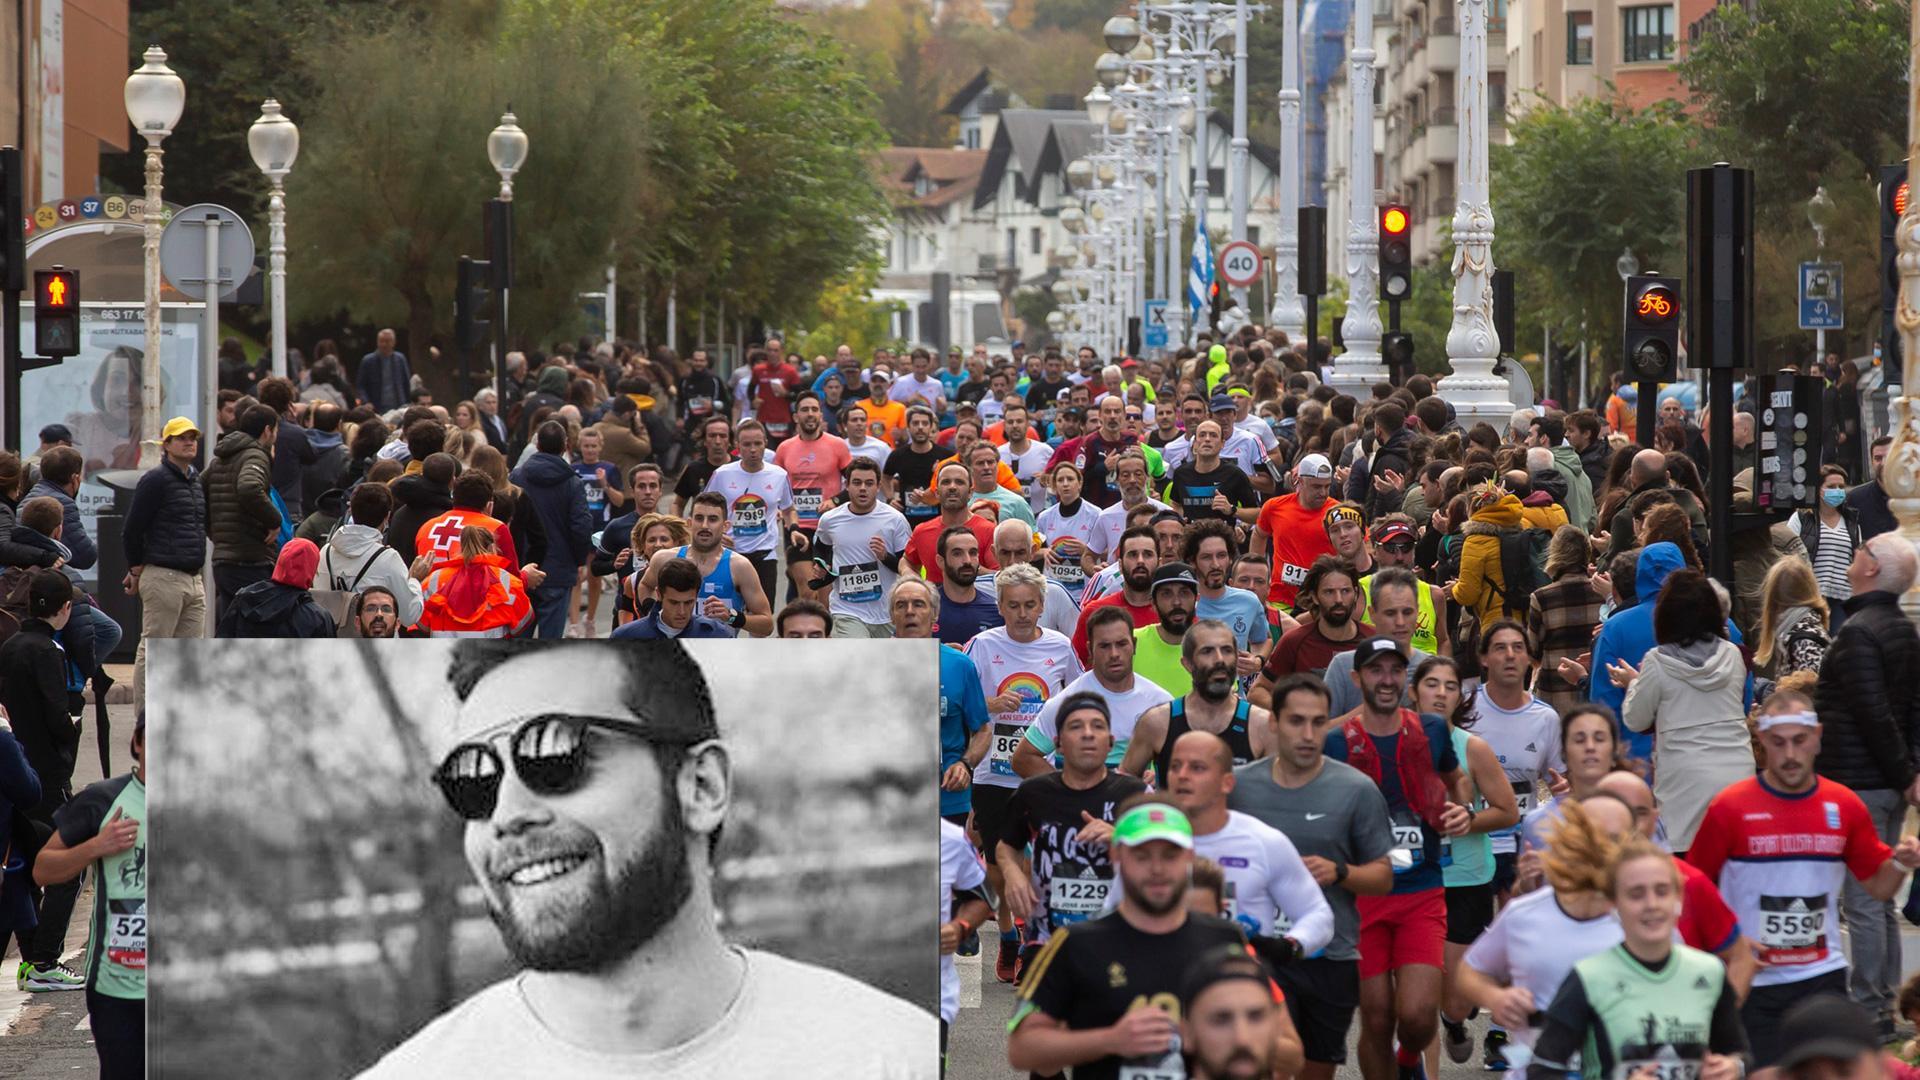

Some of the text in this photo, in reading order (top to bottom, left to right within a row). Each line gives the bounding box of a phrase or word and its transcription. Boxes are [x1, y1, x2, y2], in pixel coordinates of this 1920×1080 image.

[61, 206, 76, 216] 31
[83, 201, 99, 212] 37
[107, 202, 124, 213] B6
[38, 211, 54, 222] 24
[1228, 256, 1254, 271] 40
[101, 309, 120, 320] 663
[123, 309, 134, 319] 17
[1052, 565, 1083, 577] 10943
[842, 572, 879, 587] 11869
[1395, 830, 1420, 845] 70
[1058, 882, 1109, 900] 1229
[116, 916, 146, 938] 52
[1766, 912, 1825, 935] 5590
